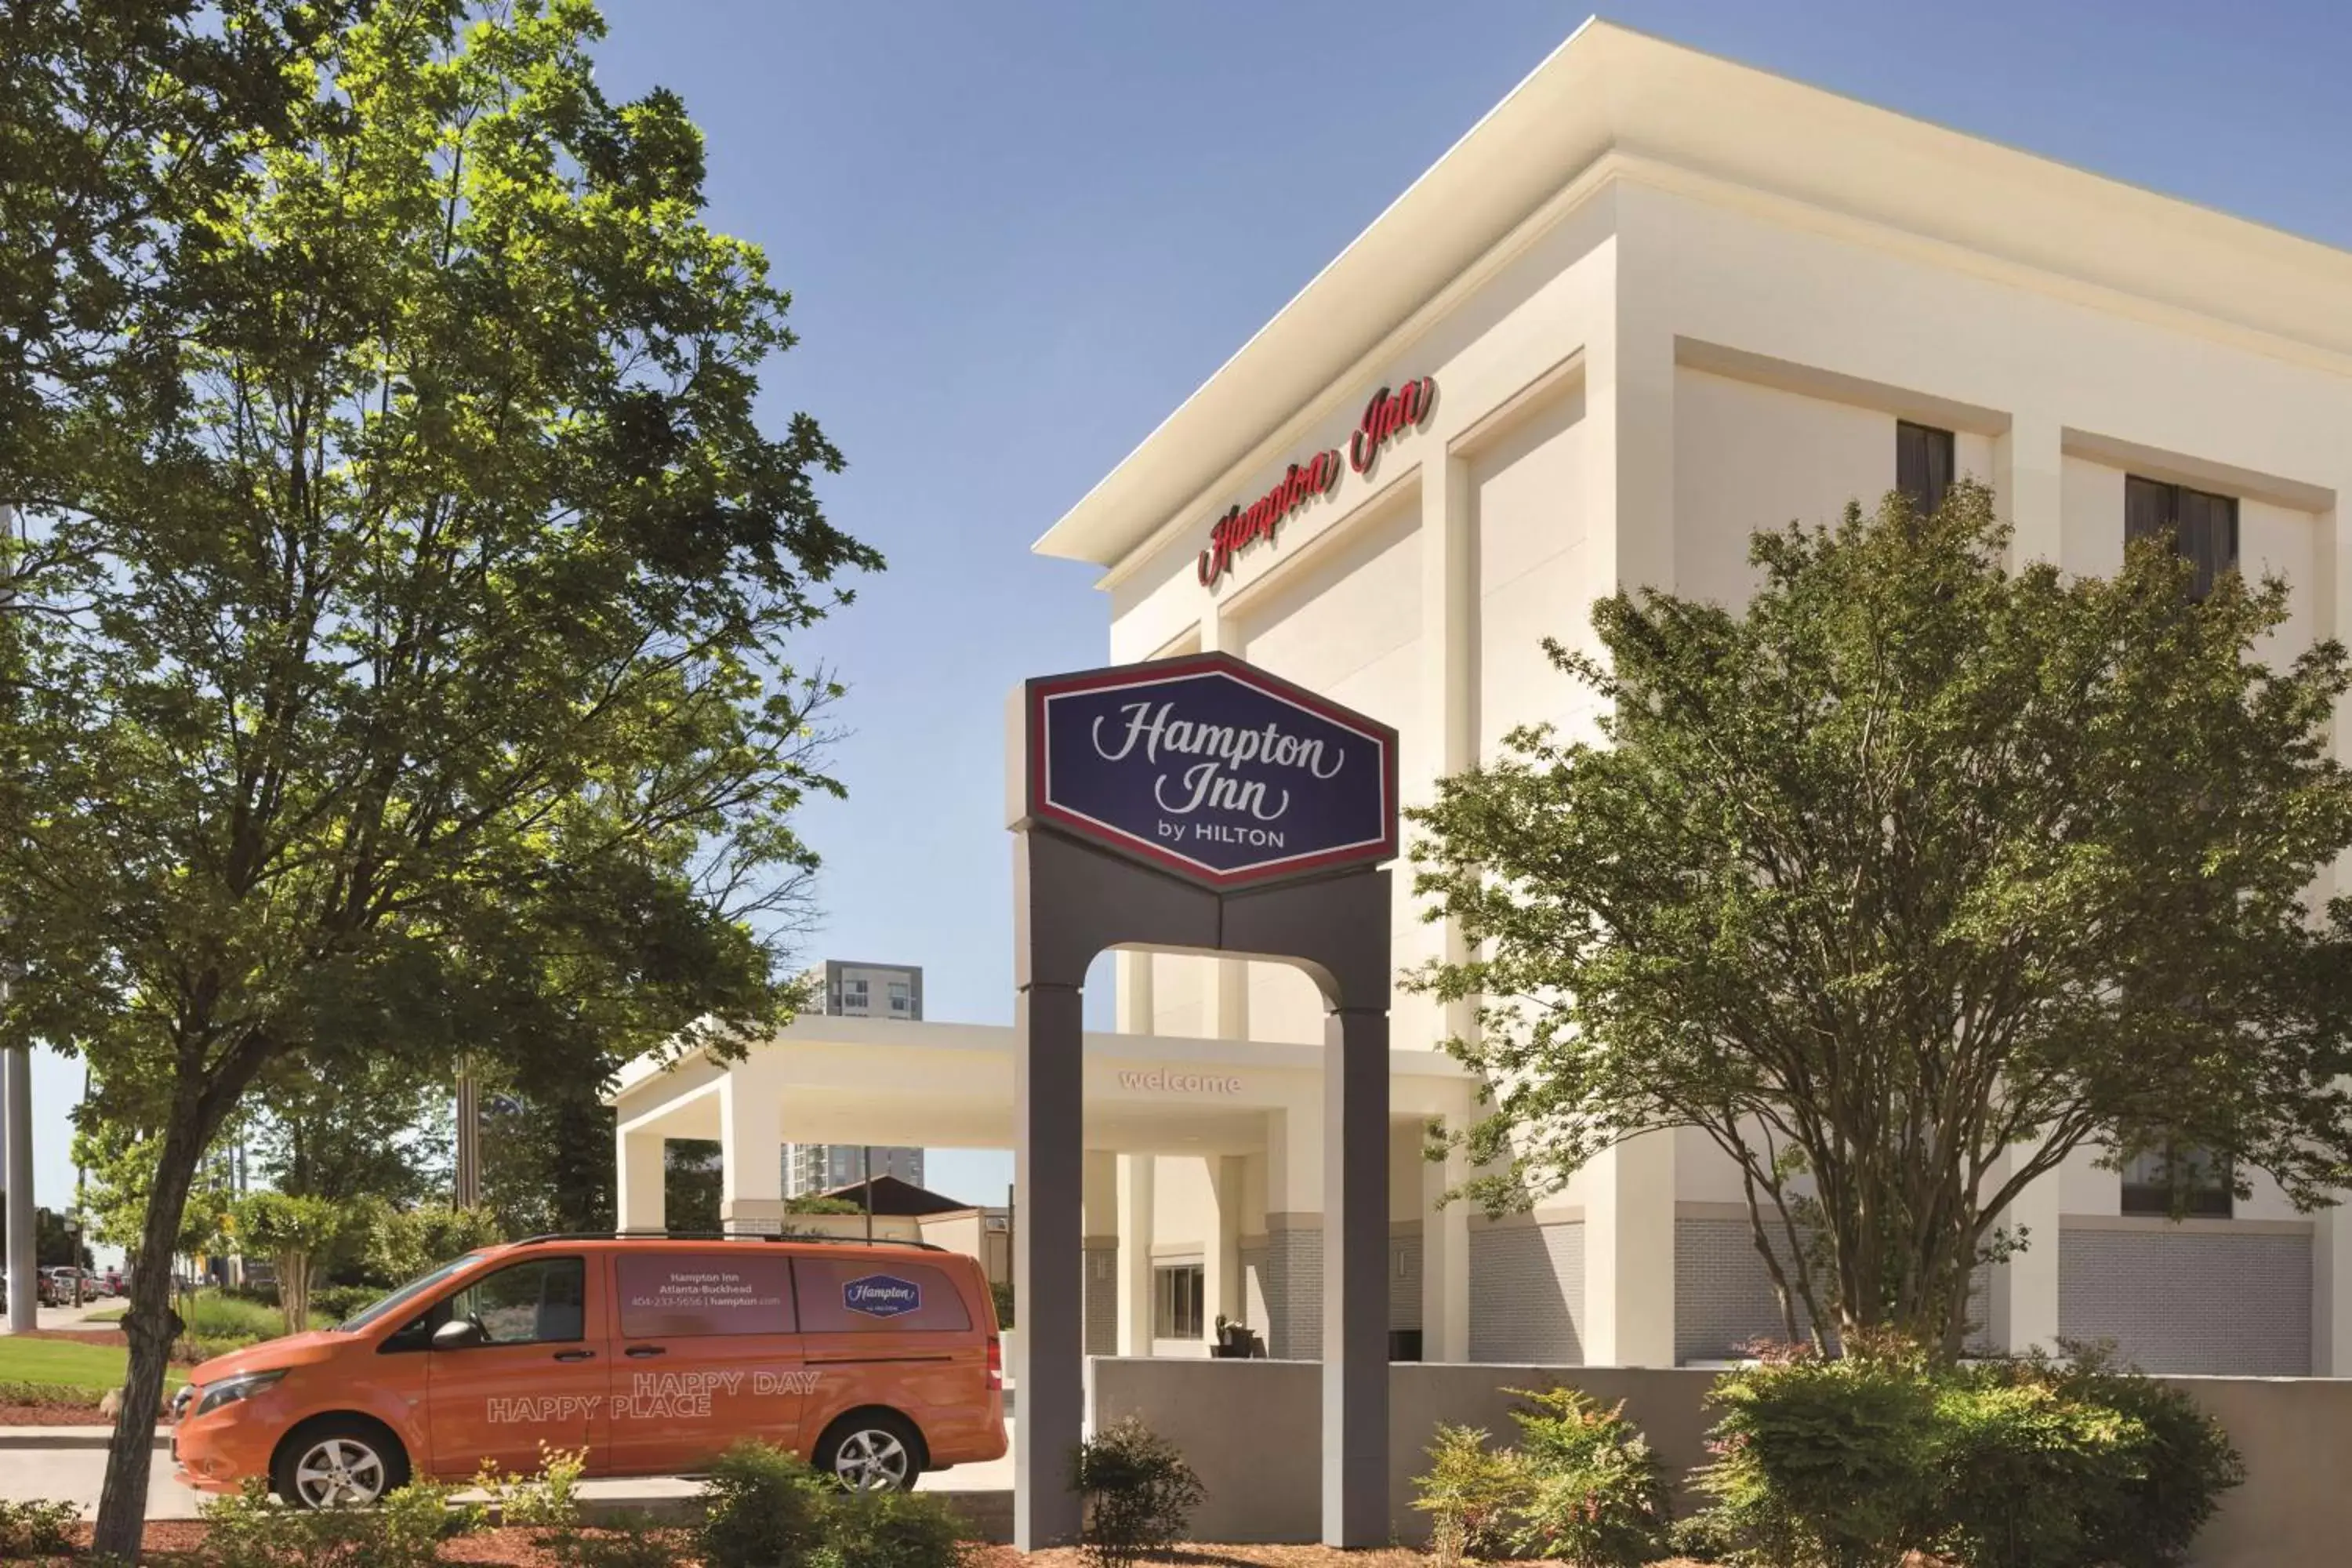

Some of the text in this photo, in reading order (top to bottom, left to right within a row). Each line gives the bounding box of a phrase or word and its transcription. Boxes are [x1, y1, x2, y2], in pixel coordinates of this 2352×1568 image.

[1198, 376, 1435, 587] Hampton Inn
[1092, 702, 1344, 779] Hampton
[1155, 762, 1289, 821] Inn
[1158, 819, 1284, 848] by HILTON
[1118, 1067, 1242, 1094] welcome
[670, 1272, 739, 1284] Hampton Inn
[848, 1285, 915, 1301] Hampton
[633, 1371, 822, 1397] HAPPY DAY
[487, 1394, 712, 1423] HAPPY PLACE
